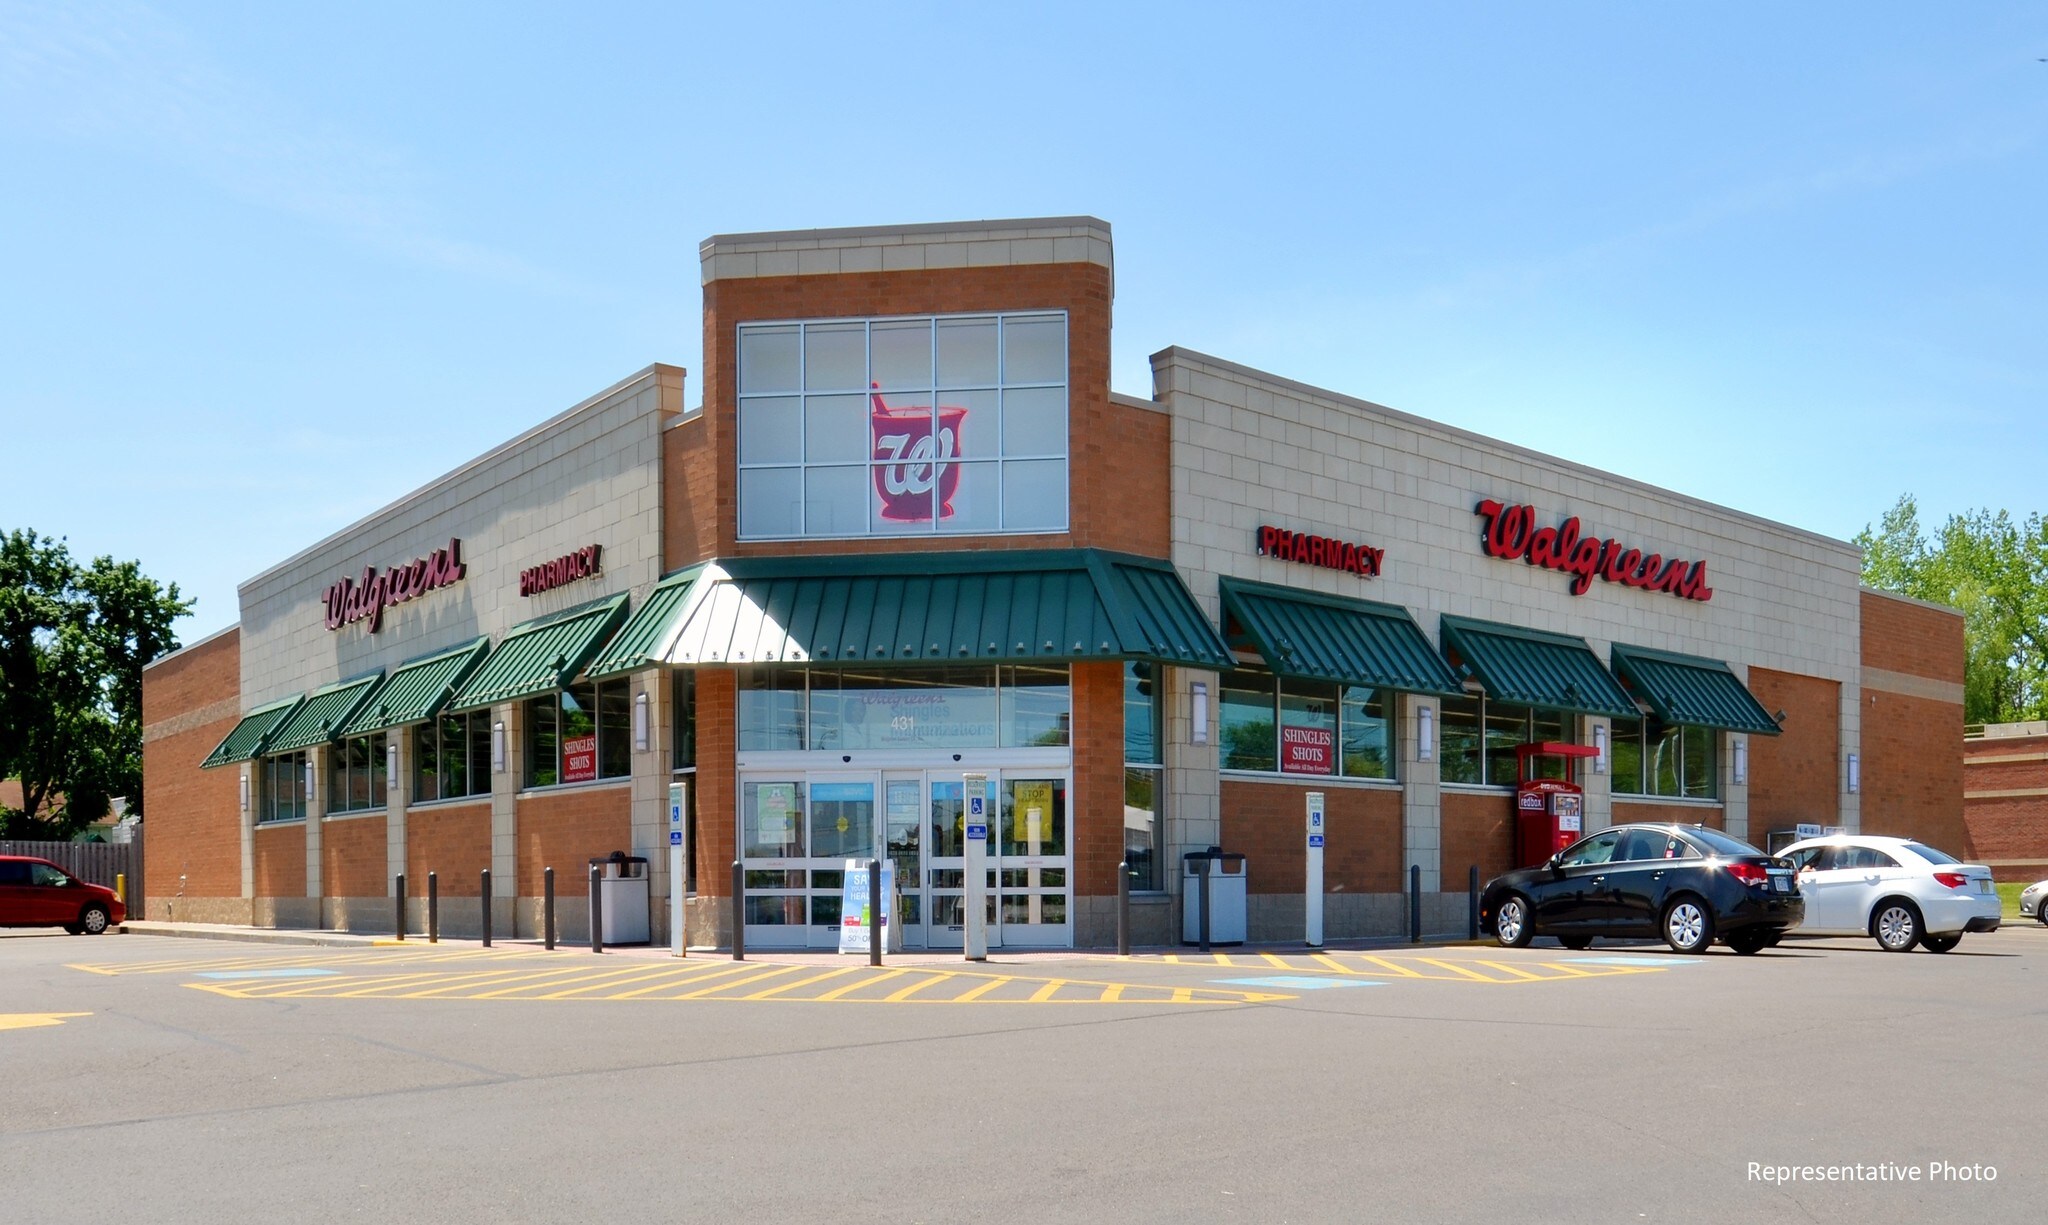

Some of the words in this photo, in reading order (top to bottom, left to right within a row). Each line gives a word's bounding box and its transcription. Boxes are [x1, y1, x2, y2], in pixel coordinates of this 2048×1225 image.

[1257, 525, 1385, 577] PHARMACY
[1475, 499, 1713, 601] Walgreens
[519, 543, 603, 598] PHARMACY
[321, 536, 468, 634] Walgreens
[890, 703, 950, 721] Shingles
[891, 715, 914, 730] 431
[1284, 728, 1331, 746] SHINGLES
[564, 738, 595, 755] SHINGLES
[1292, 746, 1323, 762] SHOTS
[569, 755, 590, 770] SHOTS
[1022, 789, 1045, 799] STOP
[1520, 796, 1542, 808] redbox
